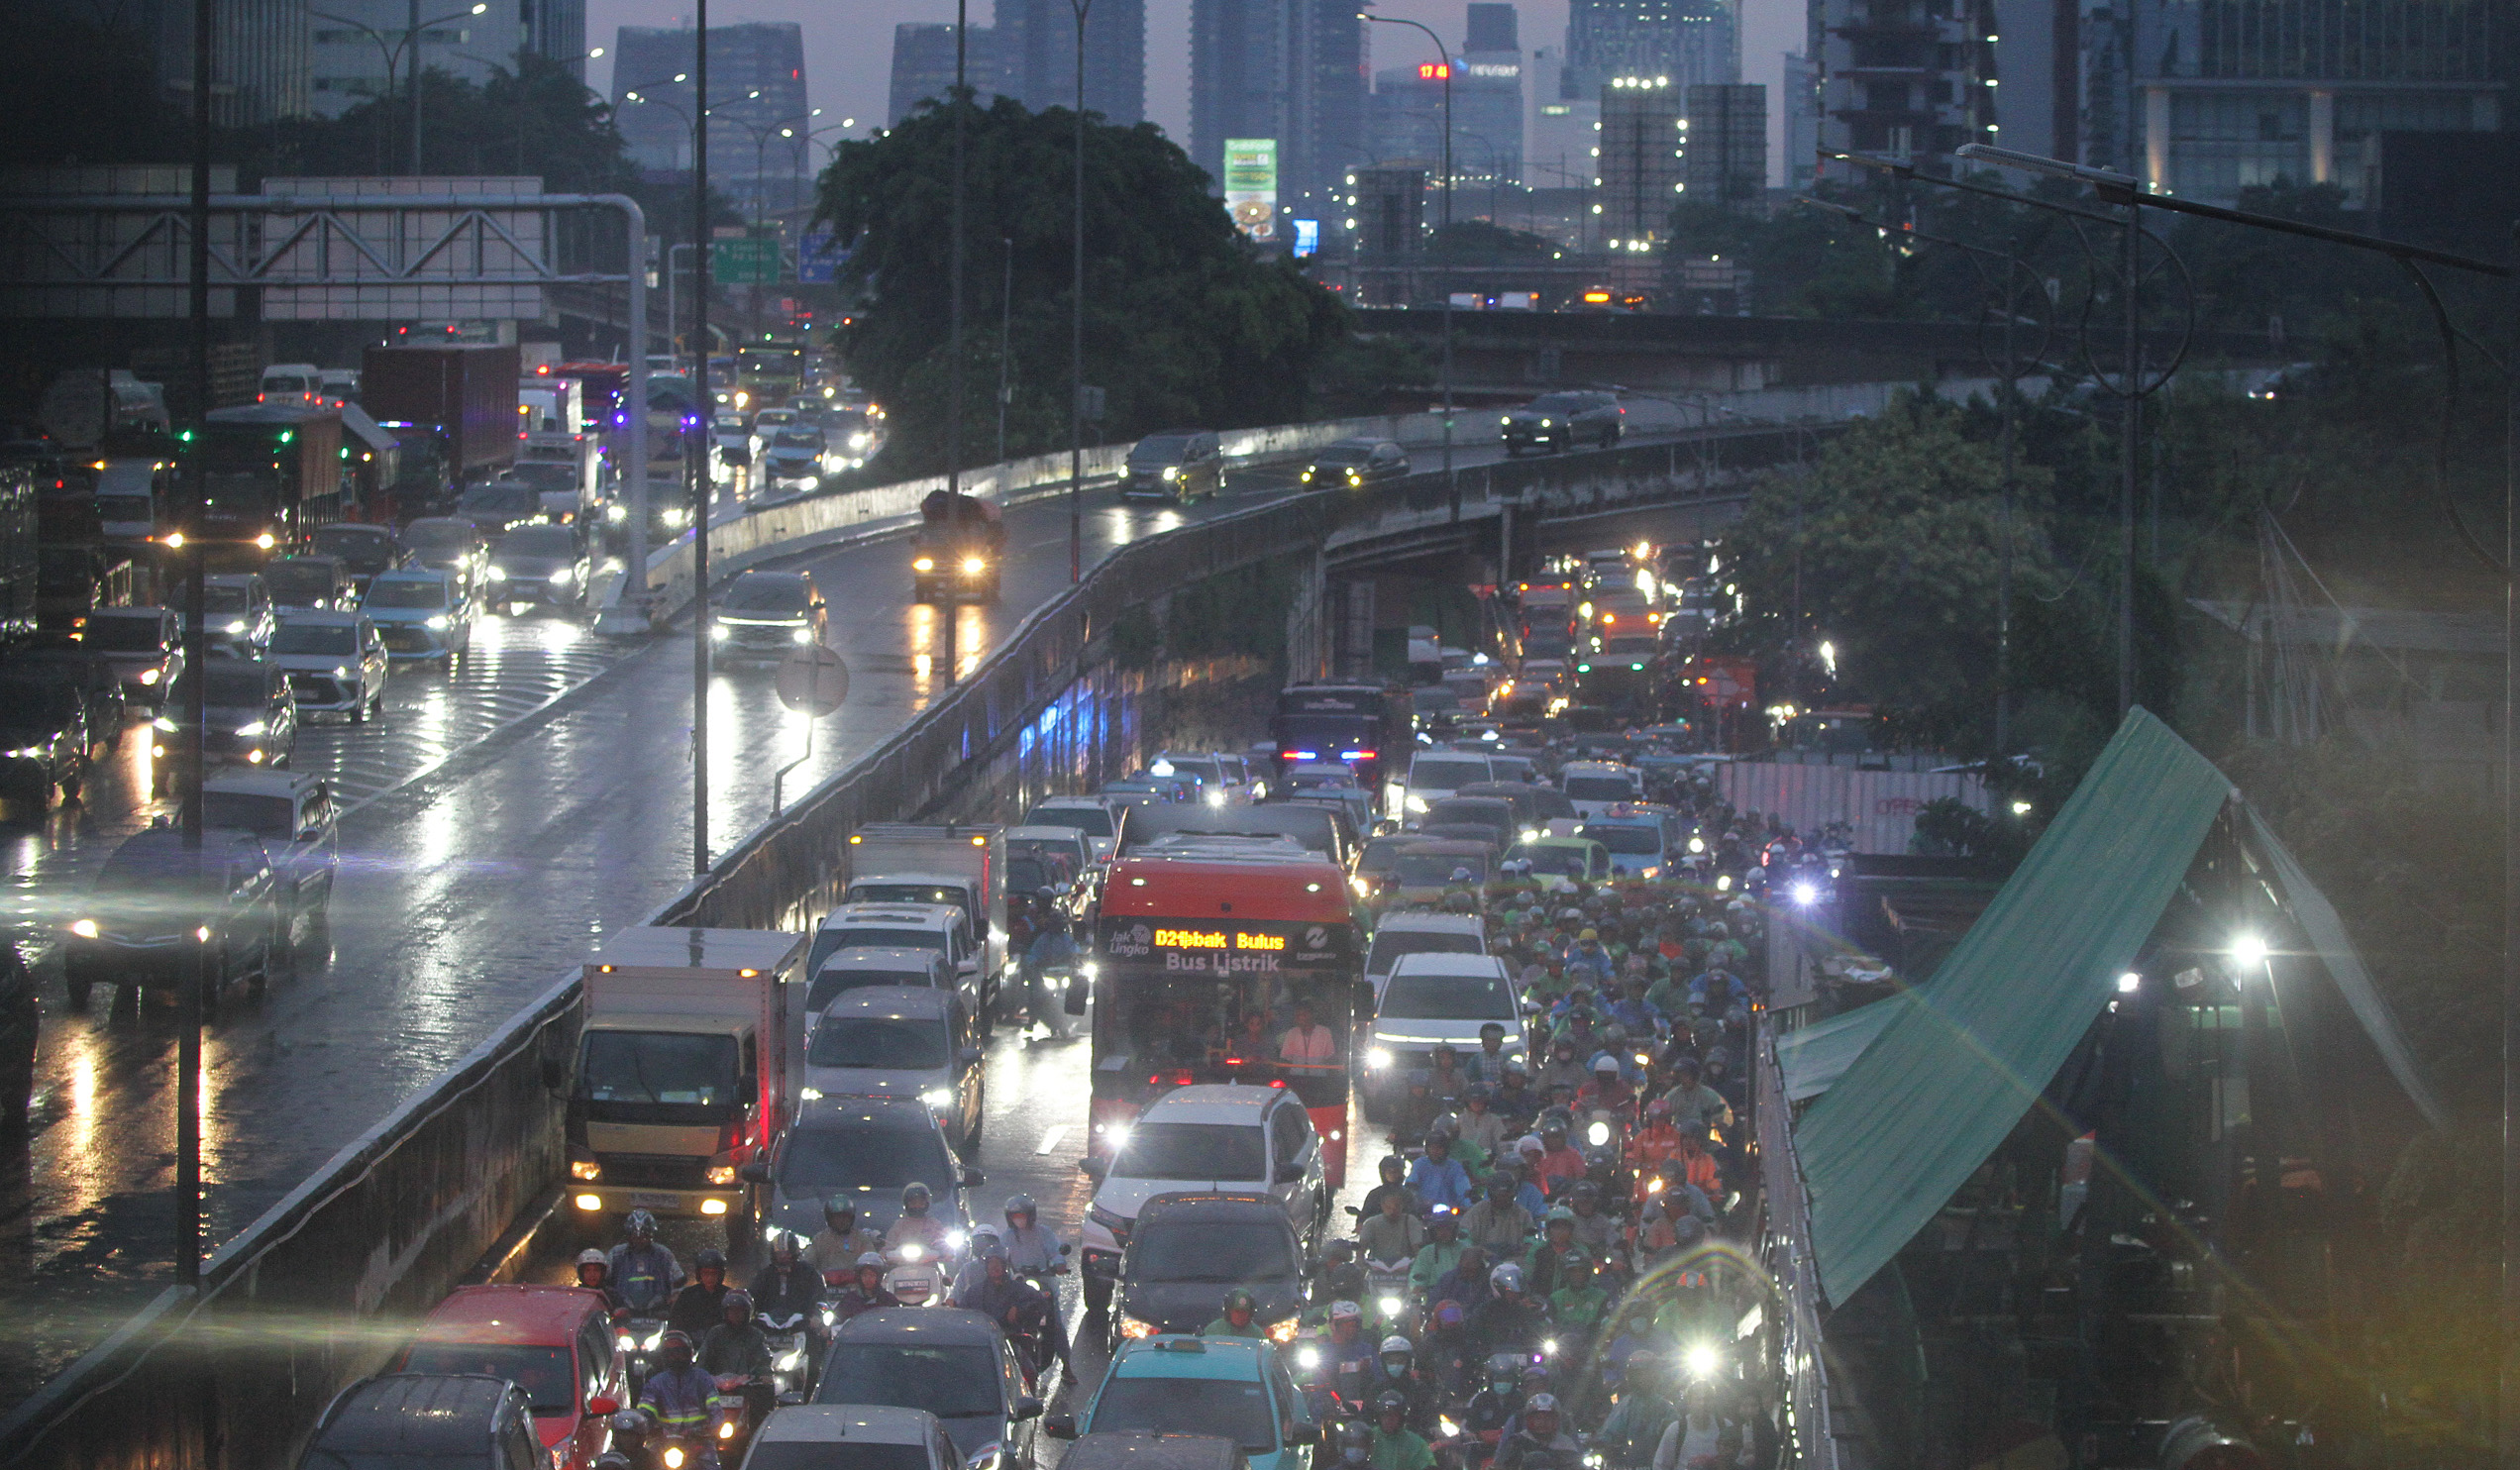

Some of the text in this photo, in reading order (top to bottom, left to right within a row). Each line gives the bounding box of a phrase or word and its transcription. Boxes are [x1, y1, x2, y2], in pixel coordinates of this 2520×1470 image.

[1110, 931, 1130, 942] Jak
[1110, 942, 1149, 957] Lingko
[1166, 952, 1206, 971] Bus
[1213, 953, 1280, 972] Listrik
